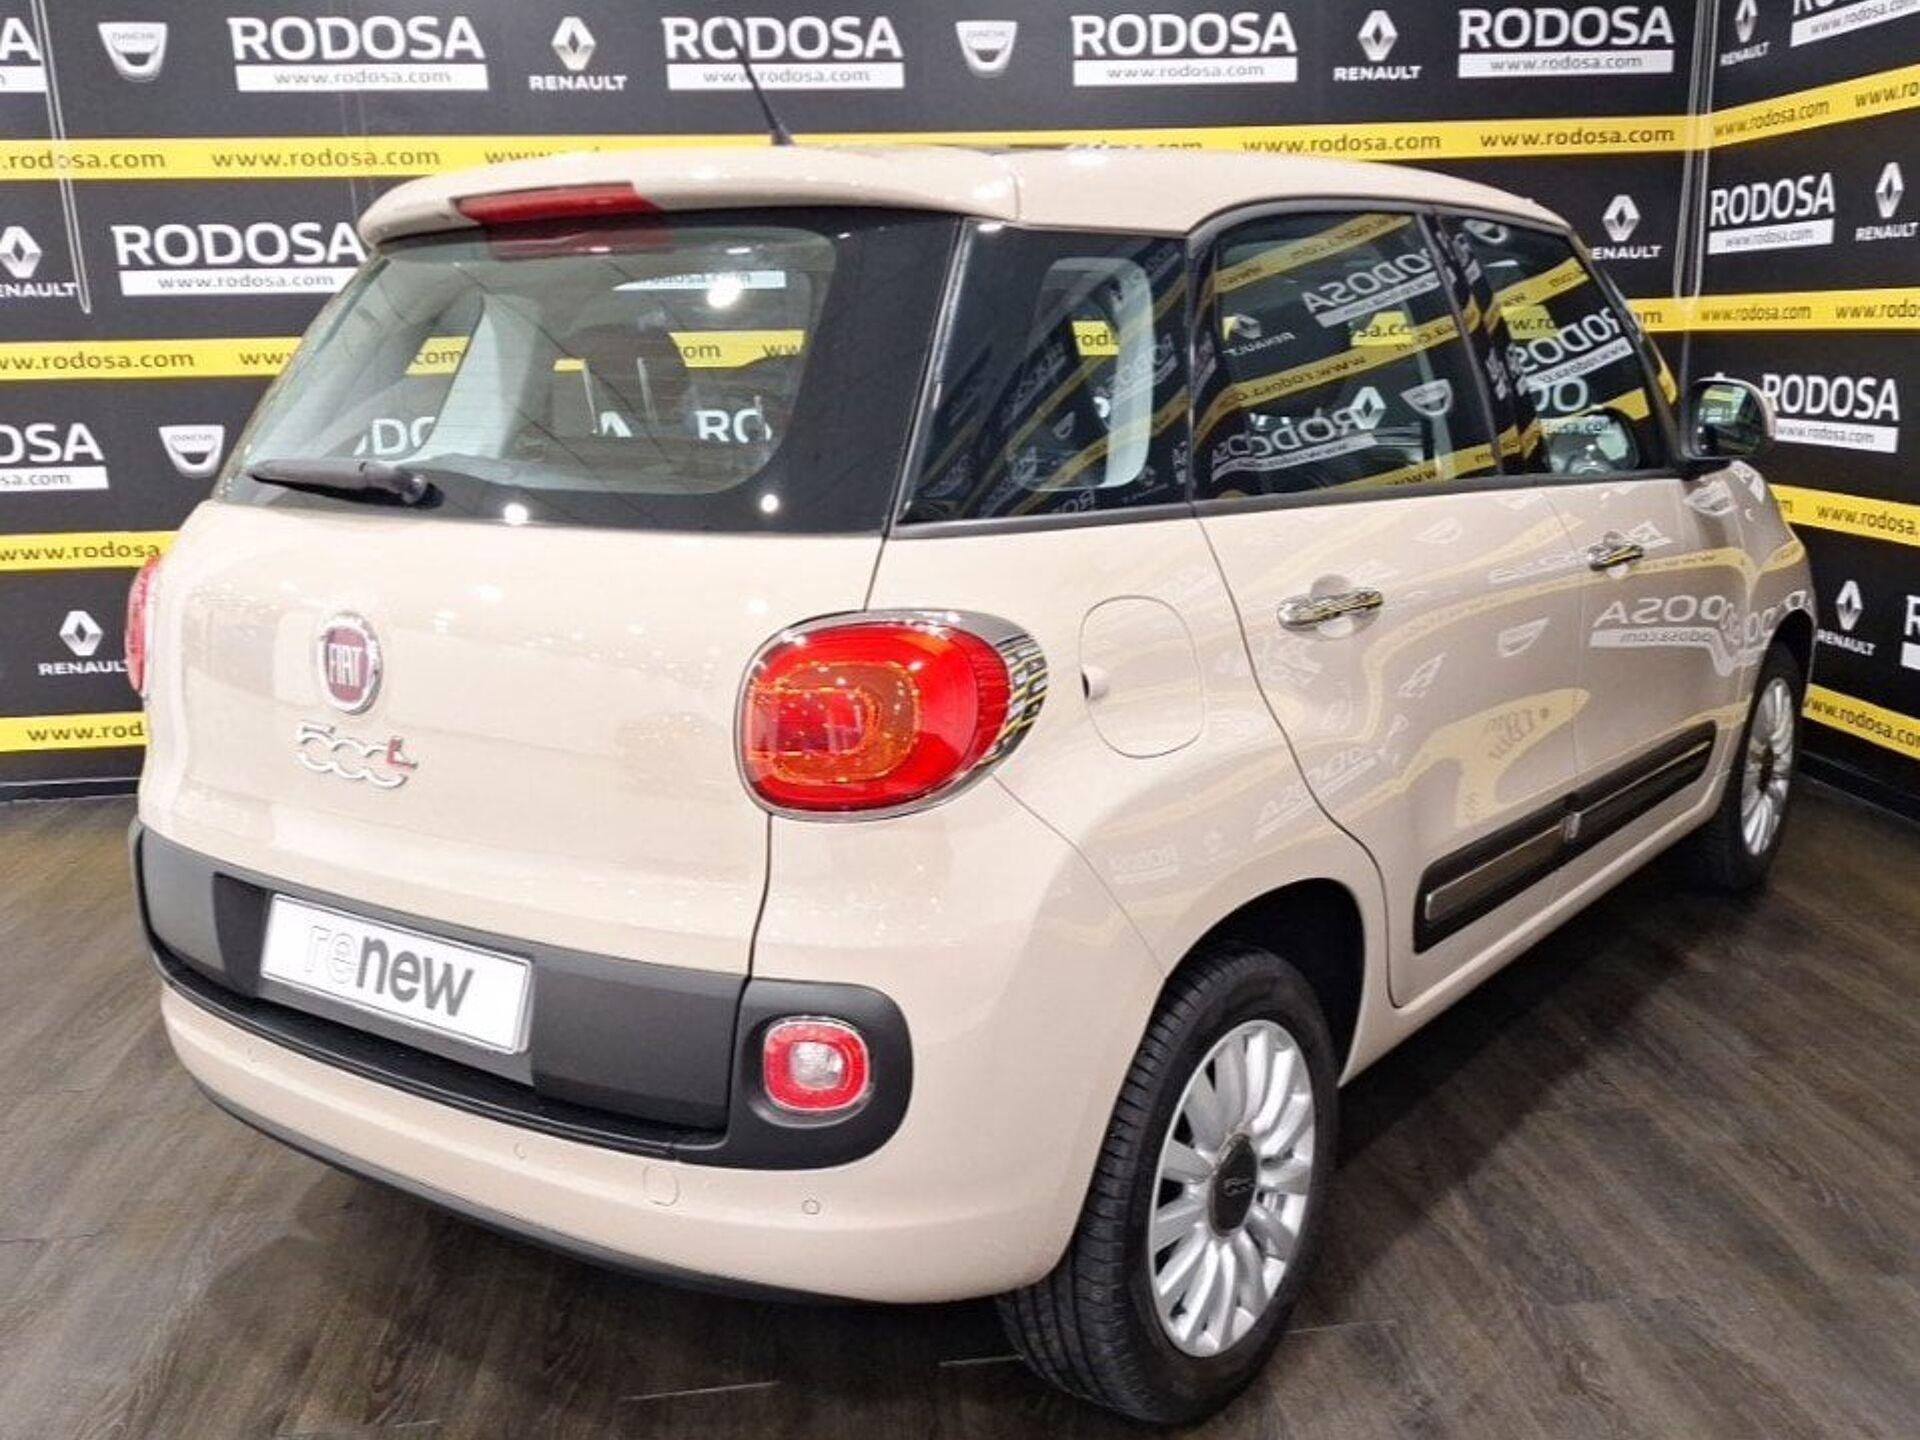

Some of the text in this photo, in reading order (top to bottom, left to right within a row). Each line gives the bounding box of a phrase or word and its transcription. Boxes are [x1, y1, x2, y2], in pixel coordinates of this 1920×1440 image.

[227, 15, 486, 60] RODOSA
[661, 15, 903, 60] RODOSA
[1070, 12, 1298, 57] RODOSA
[1458, 5, 1675, 50] RODOSA
[274, 66, 453, 86] www.rodosa.com
[1106, 61, 1266, 80] www.rodosa.com
[1333, 63, 1421, 83] RENAULT
[1489, 53, 1644, 72] www.rodosa.com
[528, 74, 628, 92] RENAULT
[1713, 100, 1830, 138] www.rodosa.com
[1242, 134, 1441, 154] www.rodosa.com
[1480, 127, 1675, 149] www.rodosa.com
[211, 144, 441, 169] www.rodosa.com
[1709, 172, 1836, 228] RODOSA
[110, 223, 368, 266] RODOSA
[1854, 222, 1920, 242] RENAULT
[1591, 245, 1663, 262] ENAULT
[157, 272, 336, 290] www.rodosa.com
[1701, 304, 1812, 322] www.rodosa.com
[1762, 373, 1900, 421] RODOSA
[1816, 628, 1878, 657] RENAULT
[328, 642, 365, 687] FIAT
[1806, 695, 1920, 751] ww.rodosa.co
[306, 925, 475, 1018] renew
